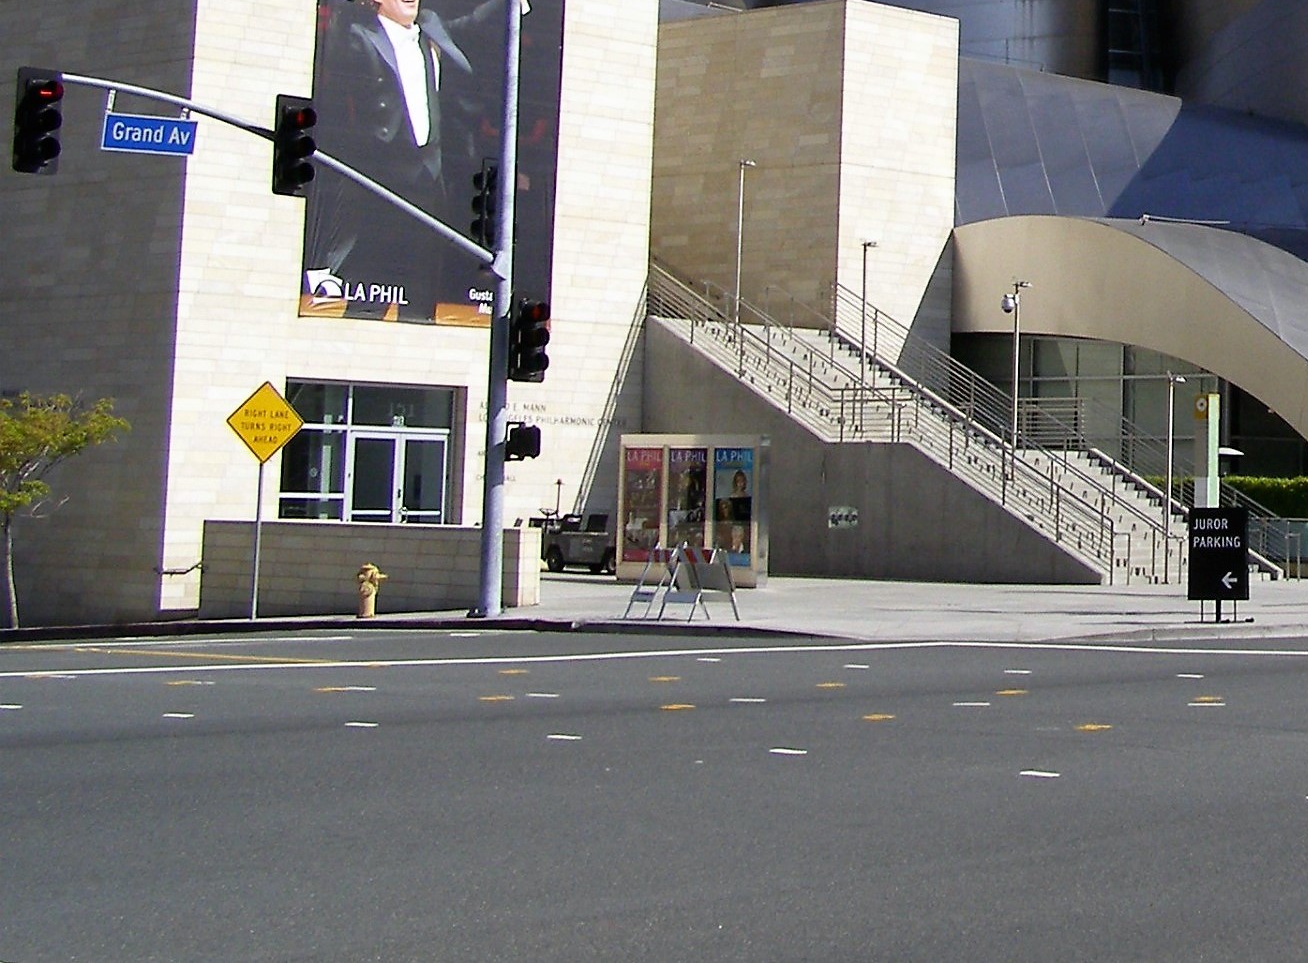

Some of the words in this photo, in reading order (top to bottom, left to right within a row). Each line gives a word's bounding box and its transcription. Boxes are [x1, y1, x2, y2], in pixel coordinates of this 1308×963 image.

[112, 122, 164, 143] Grand
[168, 127, 190, 145] Av
[345, 282, 366, 302] LA
[369, 285, 409, 305] PHIL
[523, 402, 546, 413] MANN
[244, 409, 266, 418] RIGHT
[270, 410, 289, 419] LANE
[241, 422, 265, 431] TURNS
[269, 423, 292, 432] RIGHT
[253, 435, 278, 444] AHEAD
[627, 450, 638, 462] LA
[671, 450, 682, 462] LA
[685, 450, 706, 462] PHIL
[716, 450, 728, 462] LA
[730, 450, 753, 462] PHIL
[1193, 518, 1229, 530] JUROR
[1193, 536, 1241, 548] PARKING
